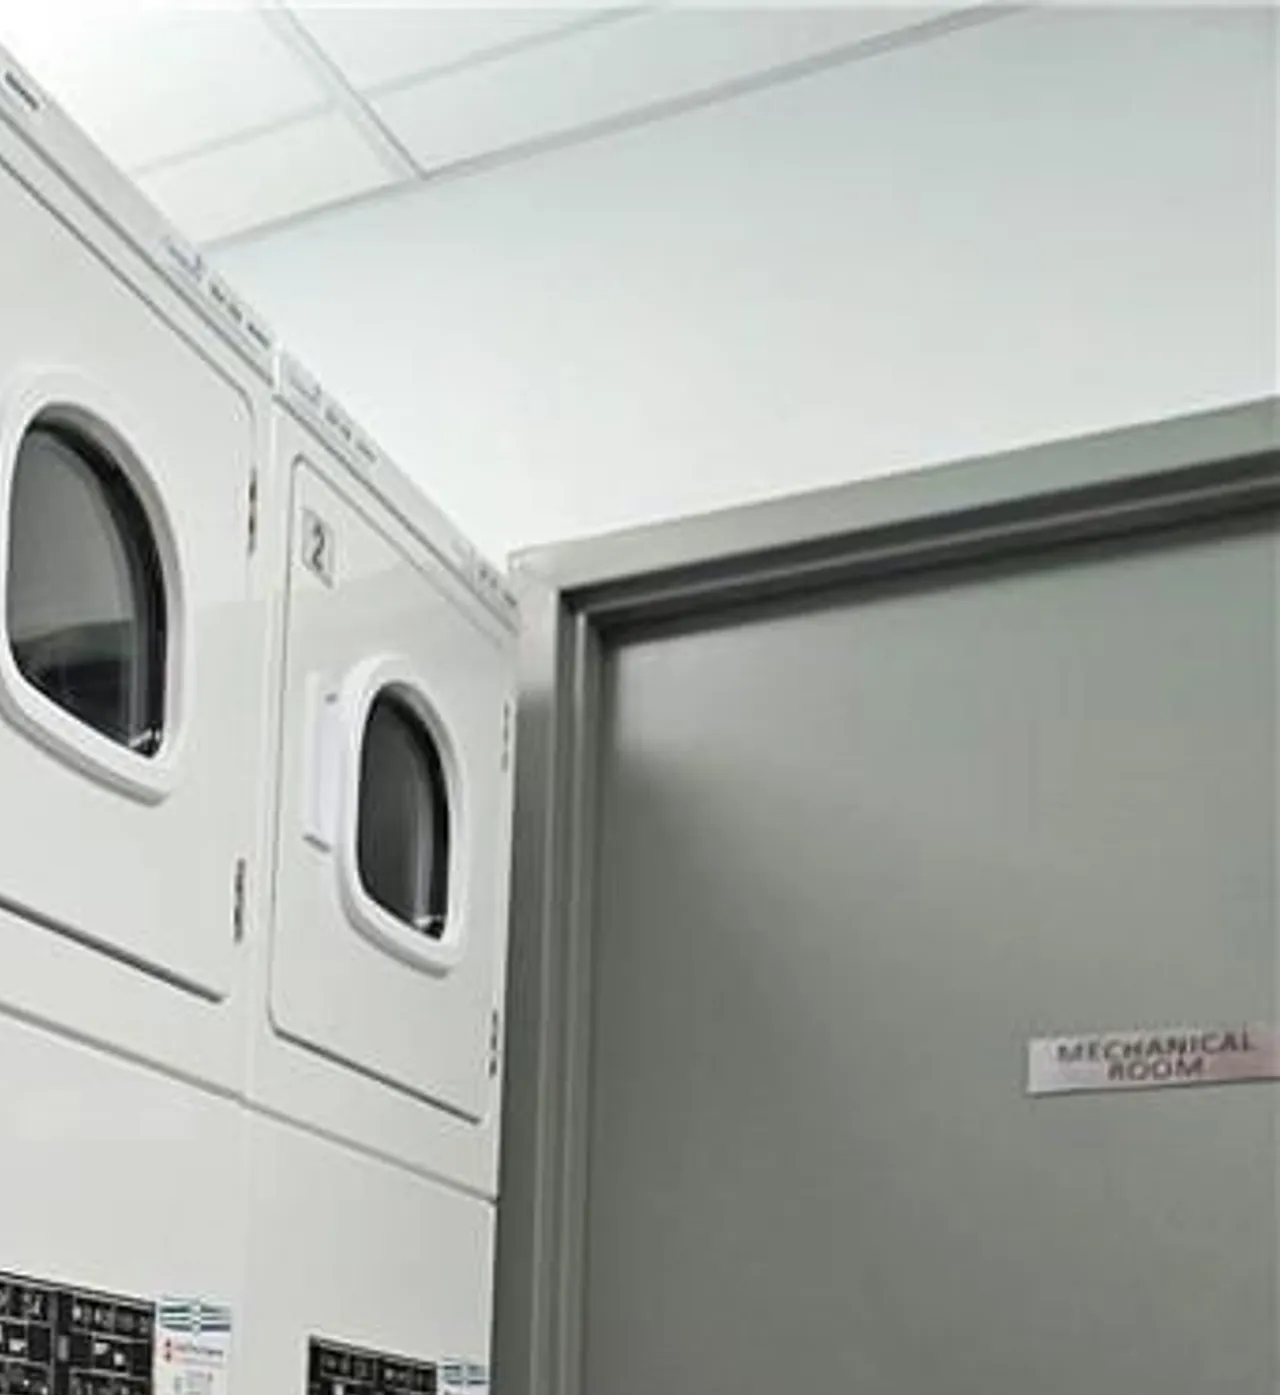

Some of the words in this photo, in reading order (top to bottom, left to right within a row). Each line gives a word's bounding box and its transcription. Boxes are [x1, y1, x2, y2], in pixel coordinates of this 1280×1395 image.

[311, 522, 326, 573] 2
[1056, 1026, 1257, 1062] MECHANICAL
[1106, 1057, 1204, 1082] ROOM
